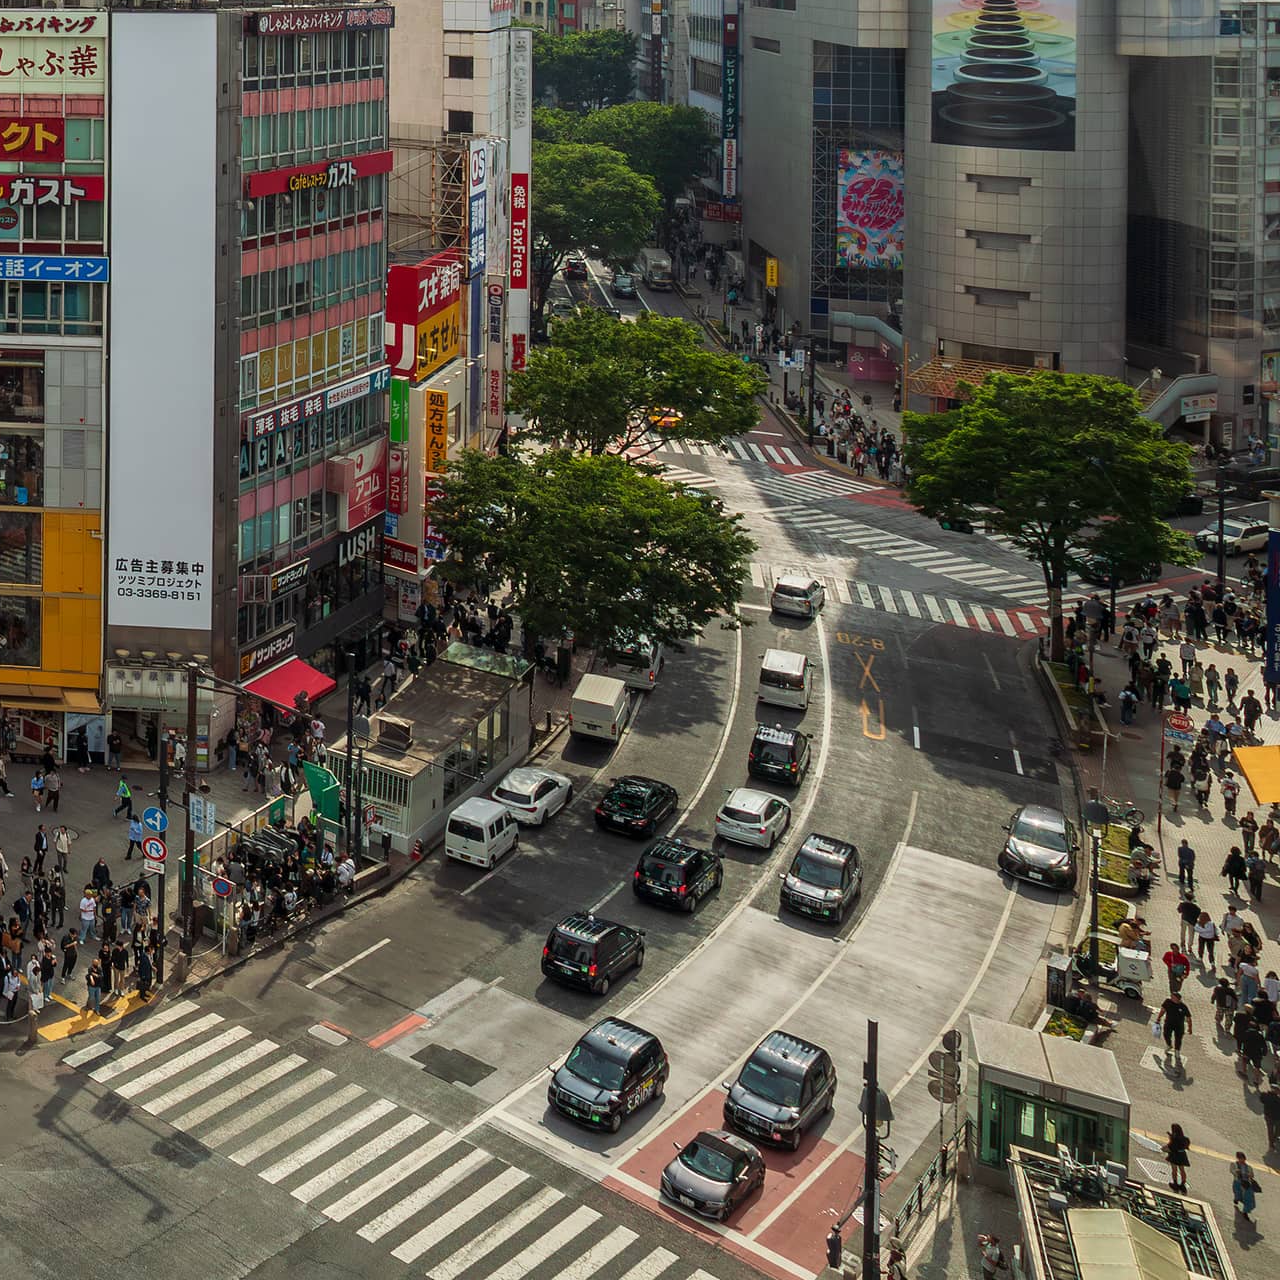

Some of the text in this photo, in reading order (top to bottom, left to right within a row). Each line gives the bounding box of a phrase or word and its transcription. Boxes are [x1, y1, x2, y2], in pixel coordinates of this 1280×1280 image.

[269, 11, 344, 32] しゃぶしゃぶバイキング
[327, 161, 356, 189] ガスト
[472, 150, 485, 183] OS
[9, 177, 86, 206] ガスト
[514, 185, 526, 209] 免税
[512, 221, 526, 278] TaxFree
[418, 262, 460, 313] スギ薬局
[374, 369, 389, 391] 4F
[429, 393, 444, 449] 処方せん
[355, 474, 380, 502] アコム
[339, 526, 376, 567] LUSH
[115, 558, 205, 577] 広告主募集中
[118, 574, 202, 588] ツツミプロジェクト
[117, 587, 202, 602] 03-3369-8151
[257, 631, 295, 664] サンドラッグ
